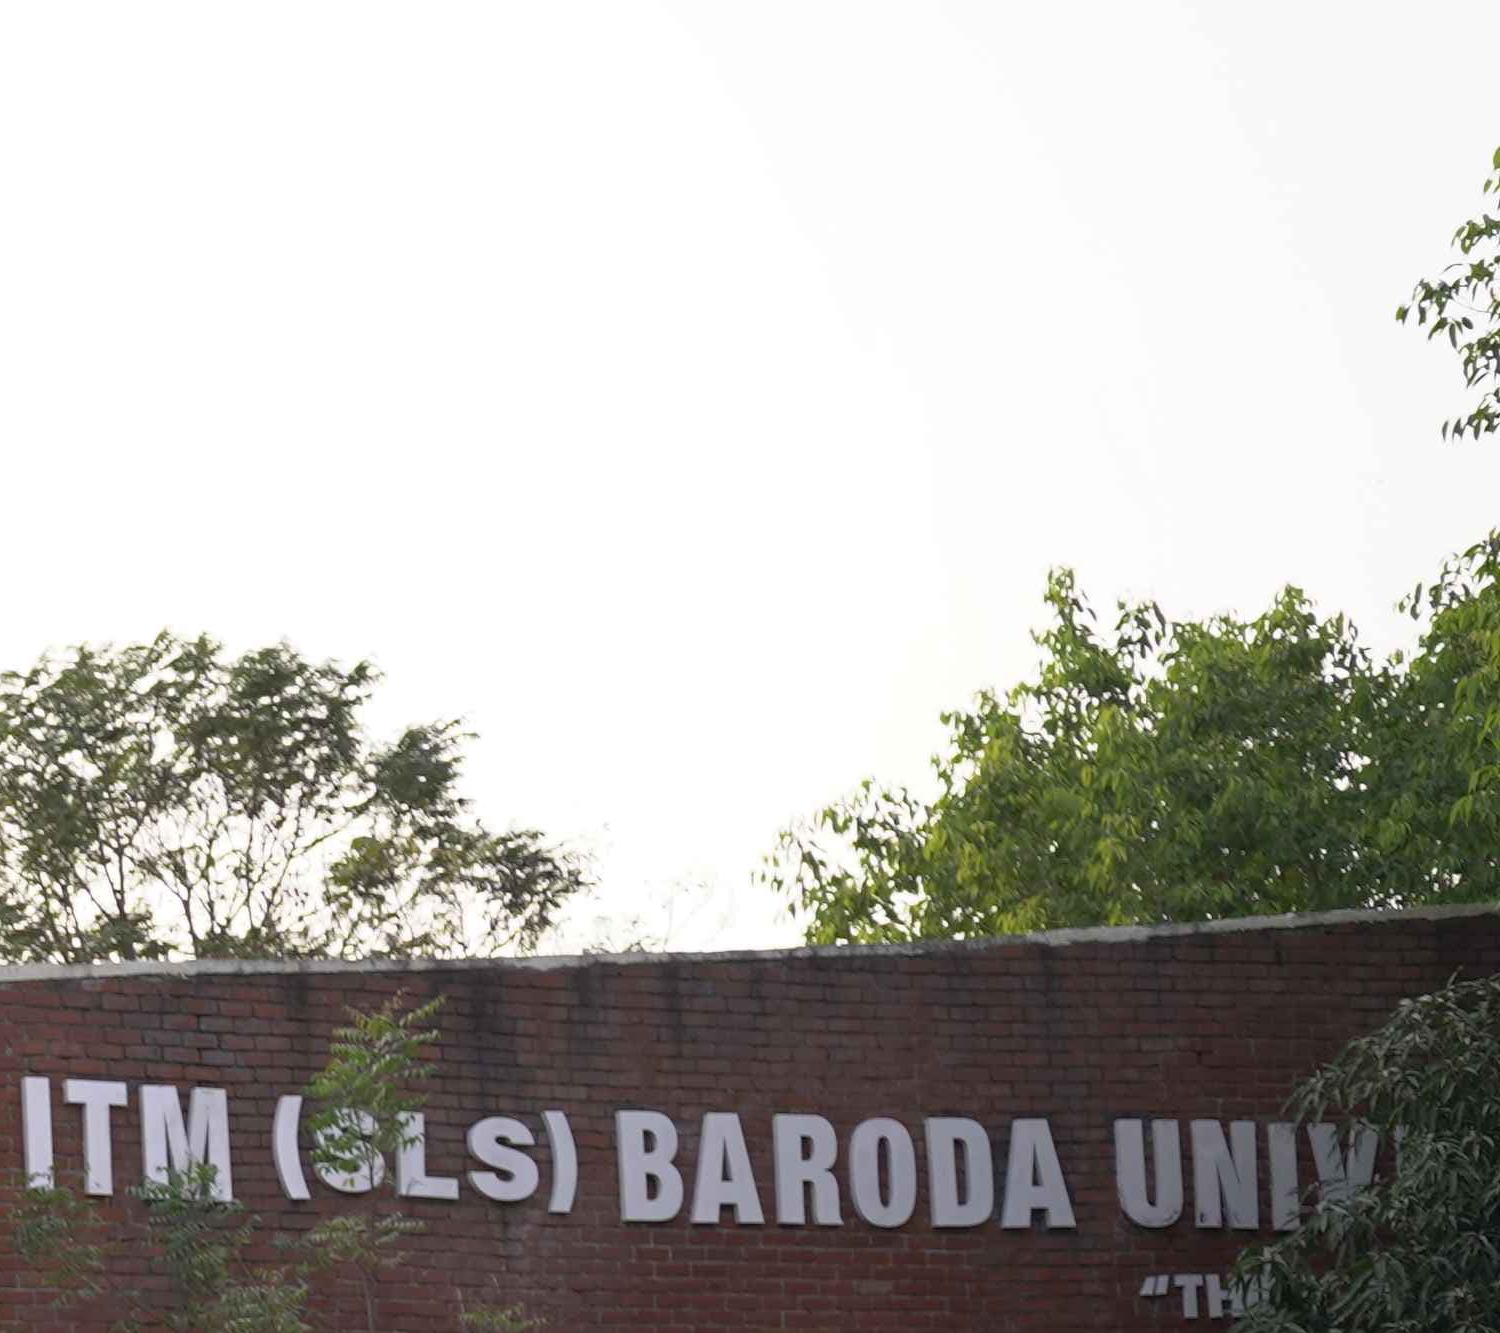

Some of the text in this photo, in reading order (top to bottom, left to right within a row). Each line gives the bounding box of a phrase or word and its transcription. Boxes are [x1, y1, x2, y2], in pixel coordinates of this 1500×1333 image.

[21, 1075, 233, 1202] ITM
[614, 1109, 1077, 1228] BARODA
[1113, 1117, 1408, 1231] UNIV
